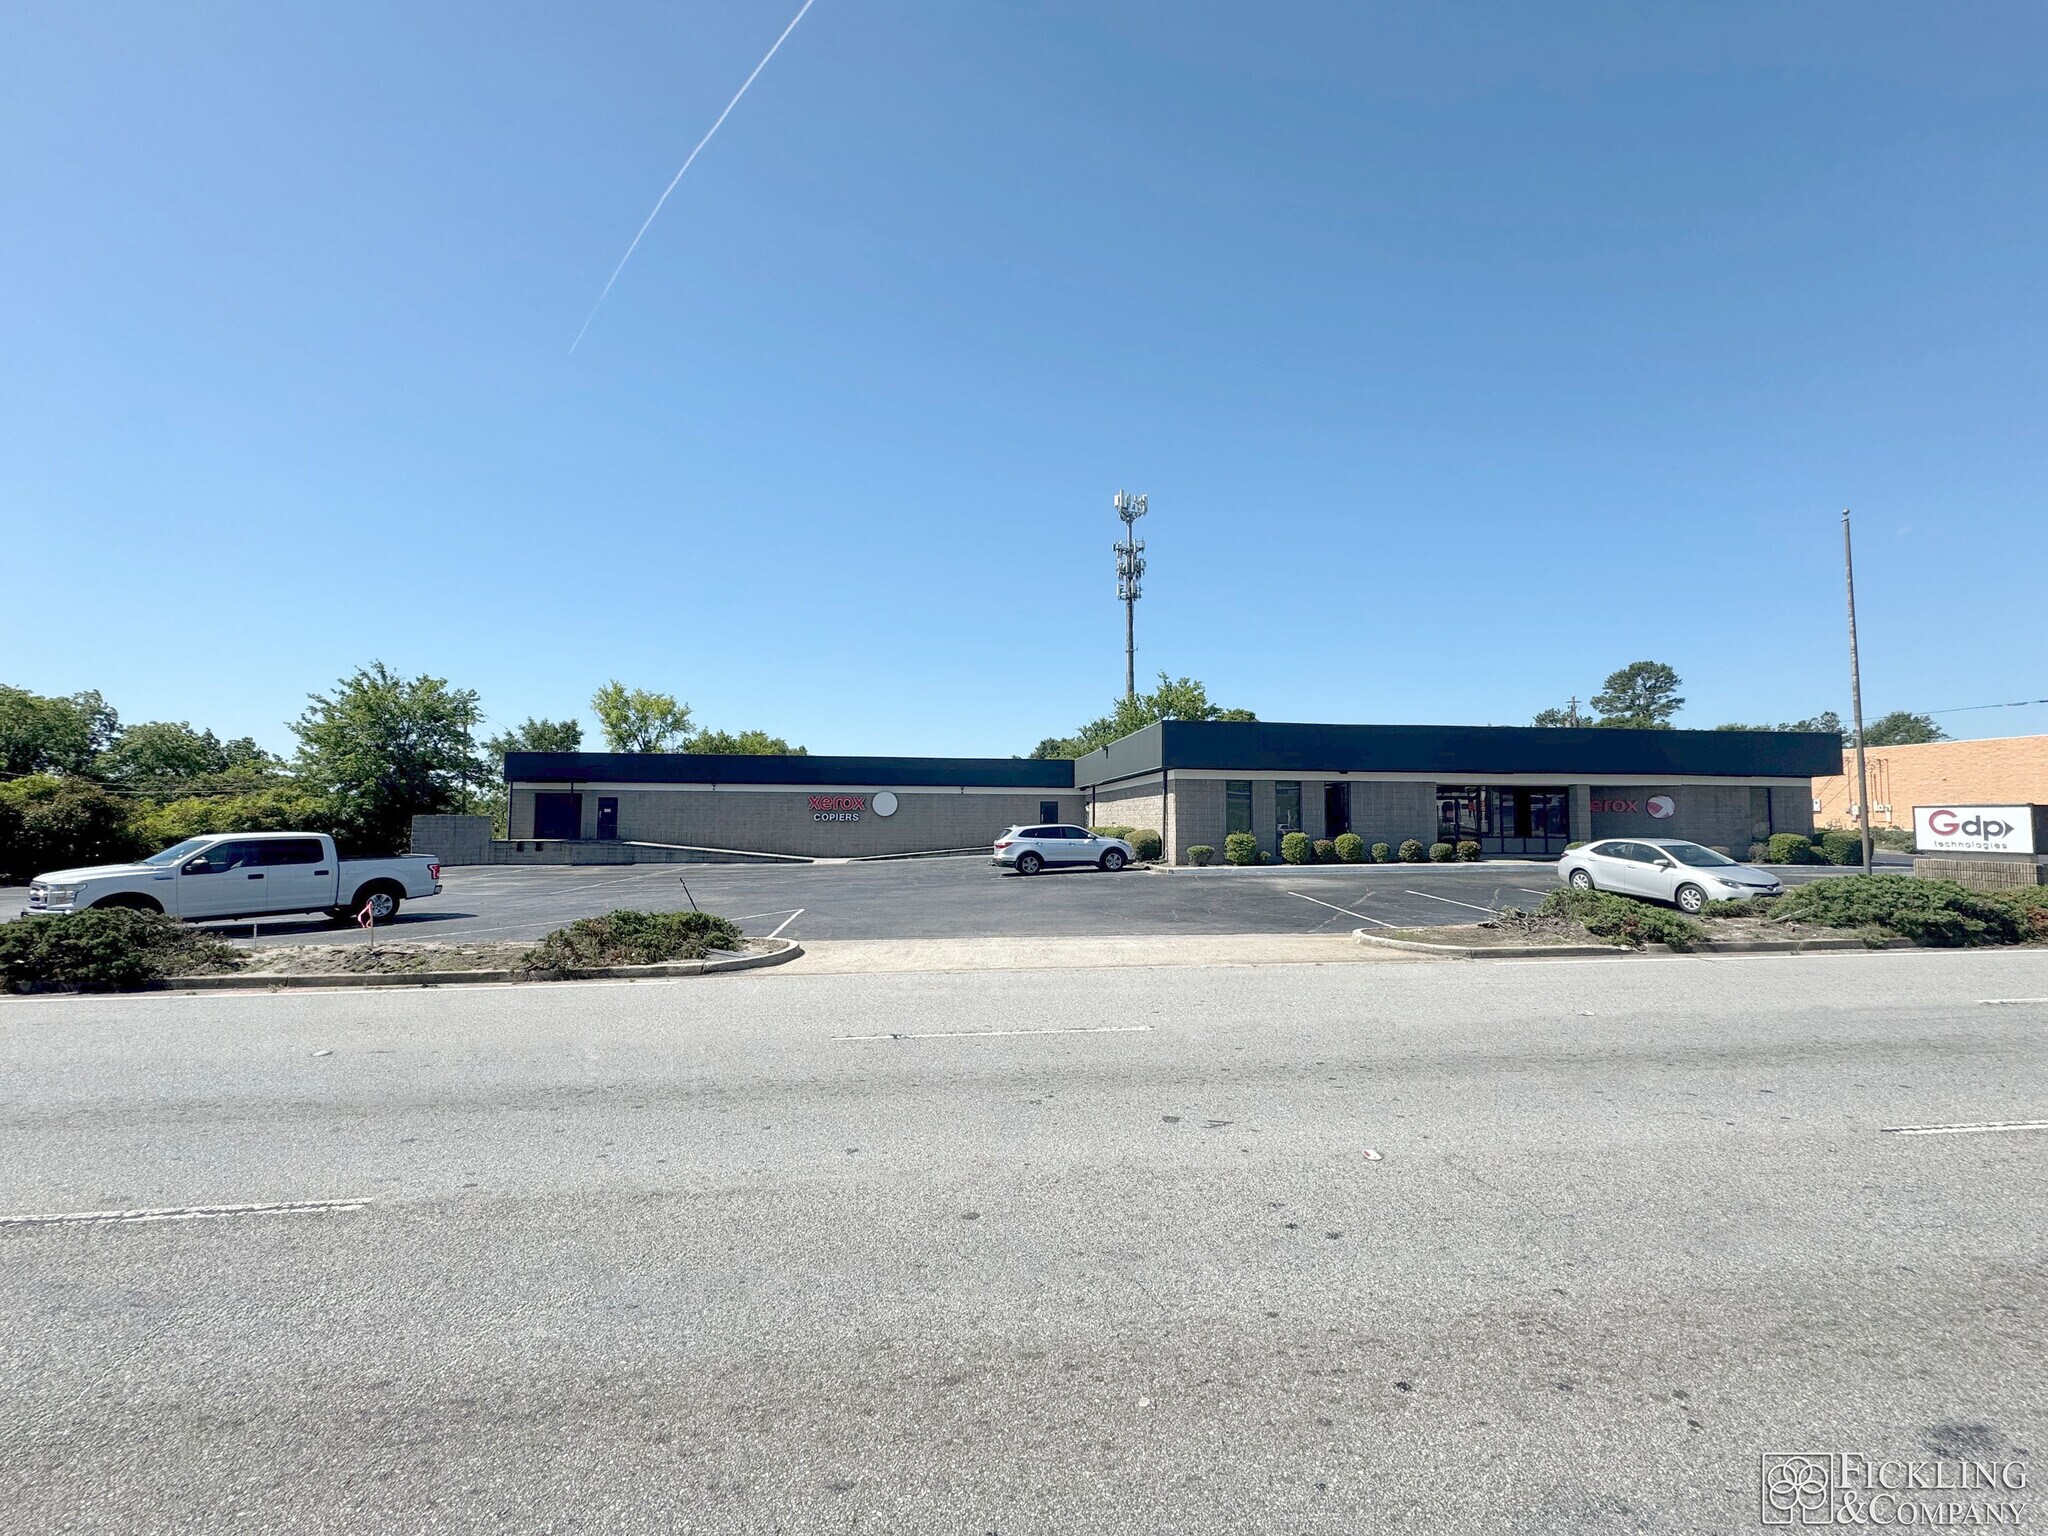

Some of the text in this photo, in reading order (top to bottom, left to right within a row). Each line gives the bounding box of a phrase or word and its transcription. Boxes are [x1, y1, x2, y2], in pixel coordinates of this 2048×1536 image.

[808, 796, 866, 811] xerox
[1590, 799, 1638, 812] erox
[813, 813, 859, 821] COPIERS
[1928, 809, 2004, 841] Gdp
[1934, 840, 2008, 850] technologies
